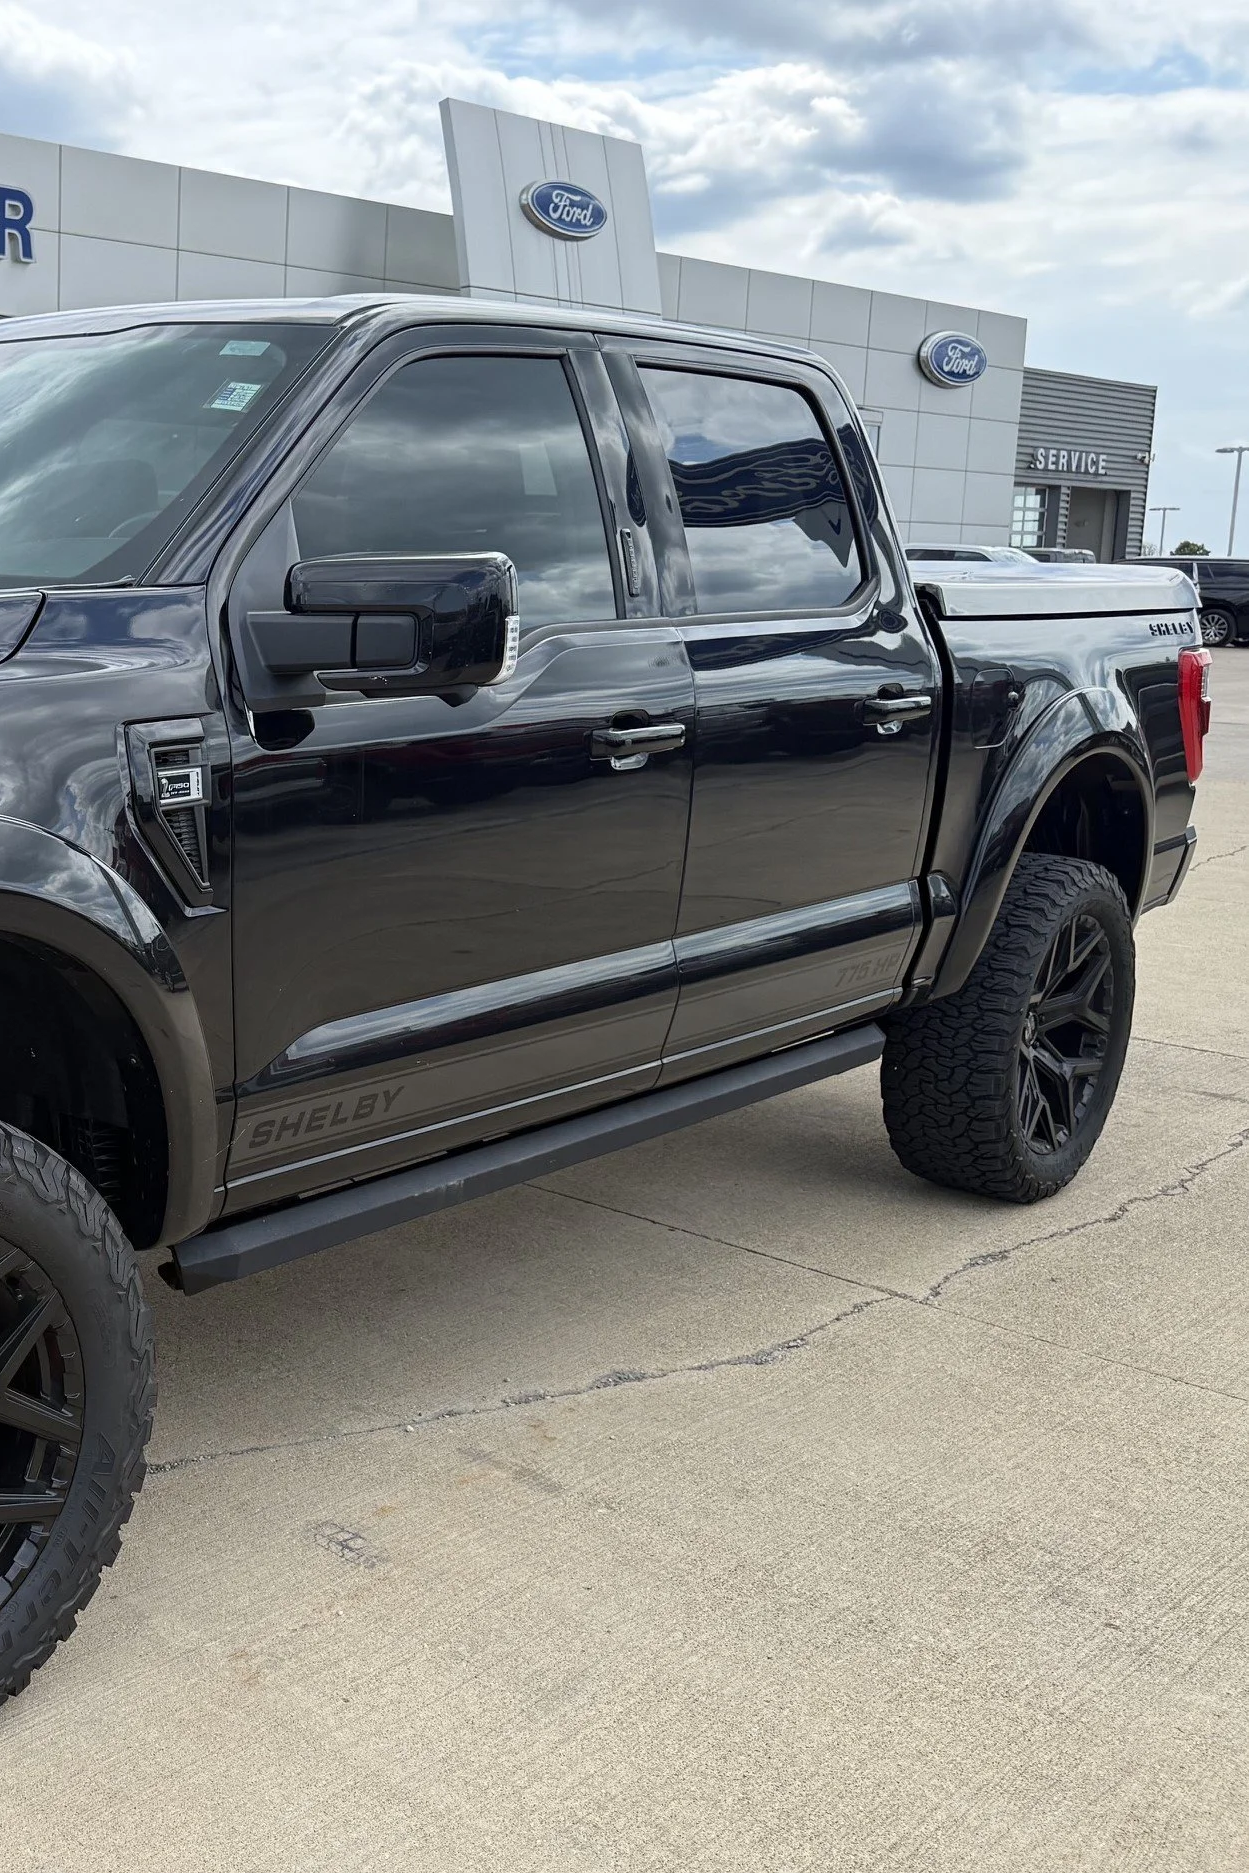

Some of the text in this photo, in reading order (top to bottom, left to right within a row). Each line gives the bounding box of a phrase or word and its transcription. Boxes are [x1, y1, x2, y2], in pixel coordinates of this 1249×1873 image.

[548, 189, 594, 226] Ford
[942, 342, 979, 376] Ford
[1035, 447, 1108, 475] SERVICE
[1148, 621, 1195, 637] SHELBY
[248, 1085, 405, 1149] SHELBY
